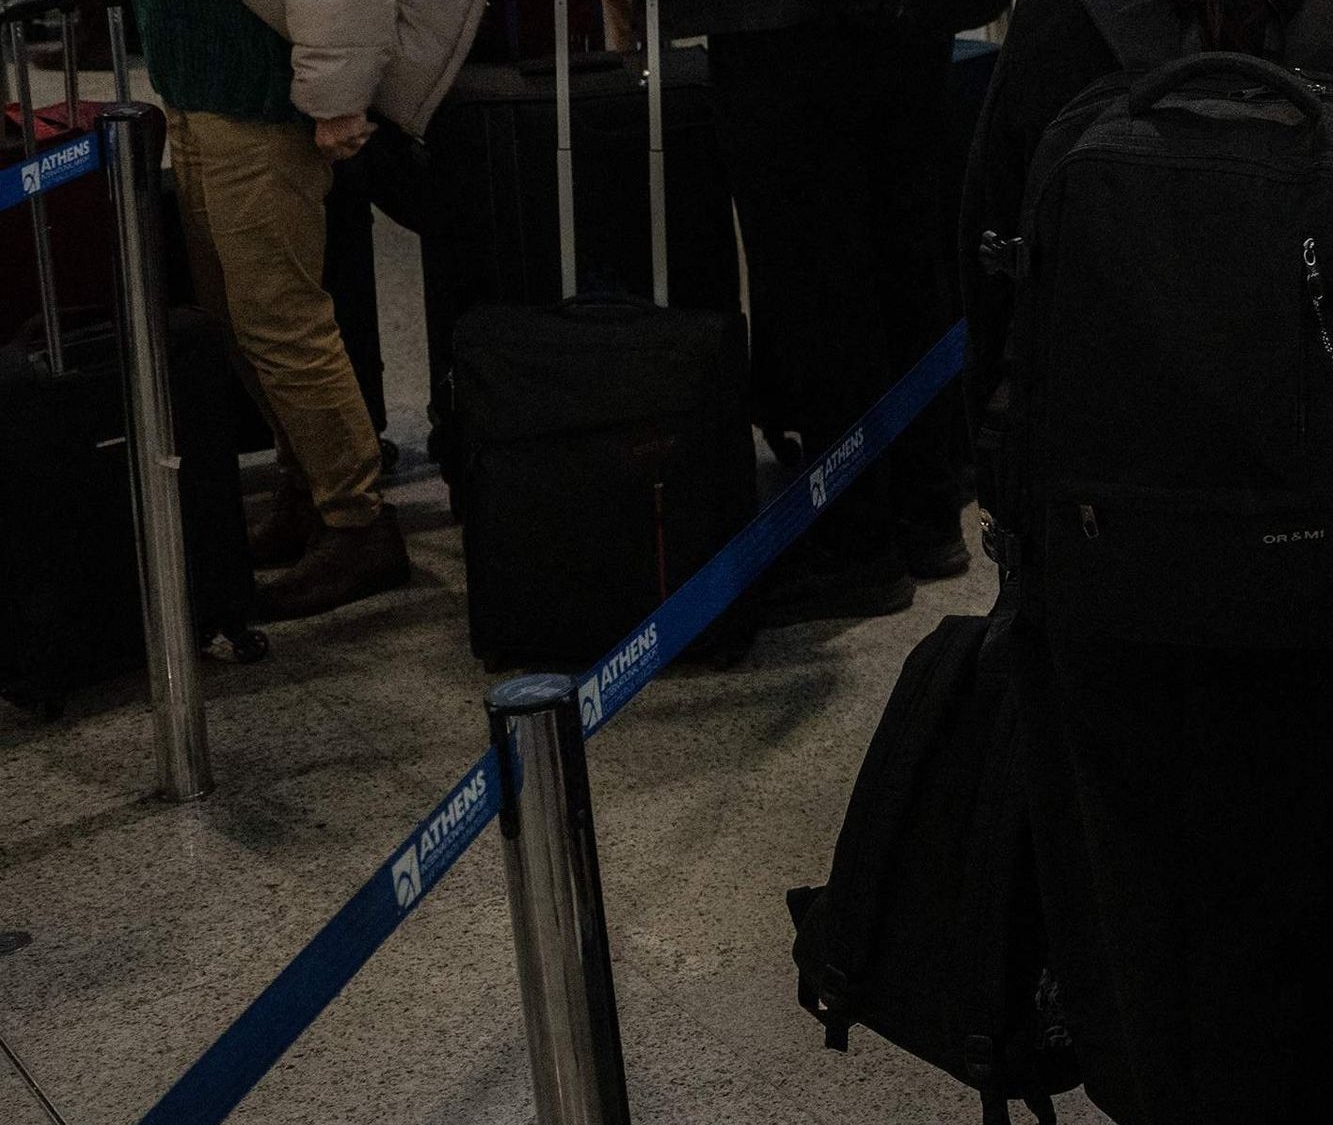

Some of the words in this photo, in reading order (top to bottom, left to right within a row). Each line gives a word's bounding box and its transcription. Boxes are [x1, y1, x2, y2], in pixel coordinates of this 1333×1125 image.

[40, 140, 90, 174] ATHENS
[824, 426, 864, 479] ATHENS
[601, 622, 657, 691] ATHENS
[420, 769, 487, 864] ATHENS
